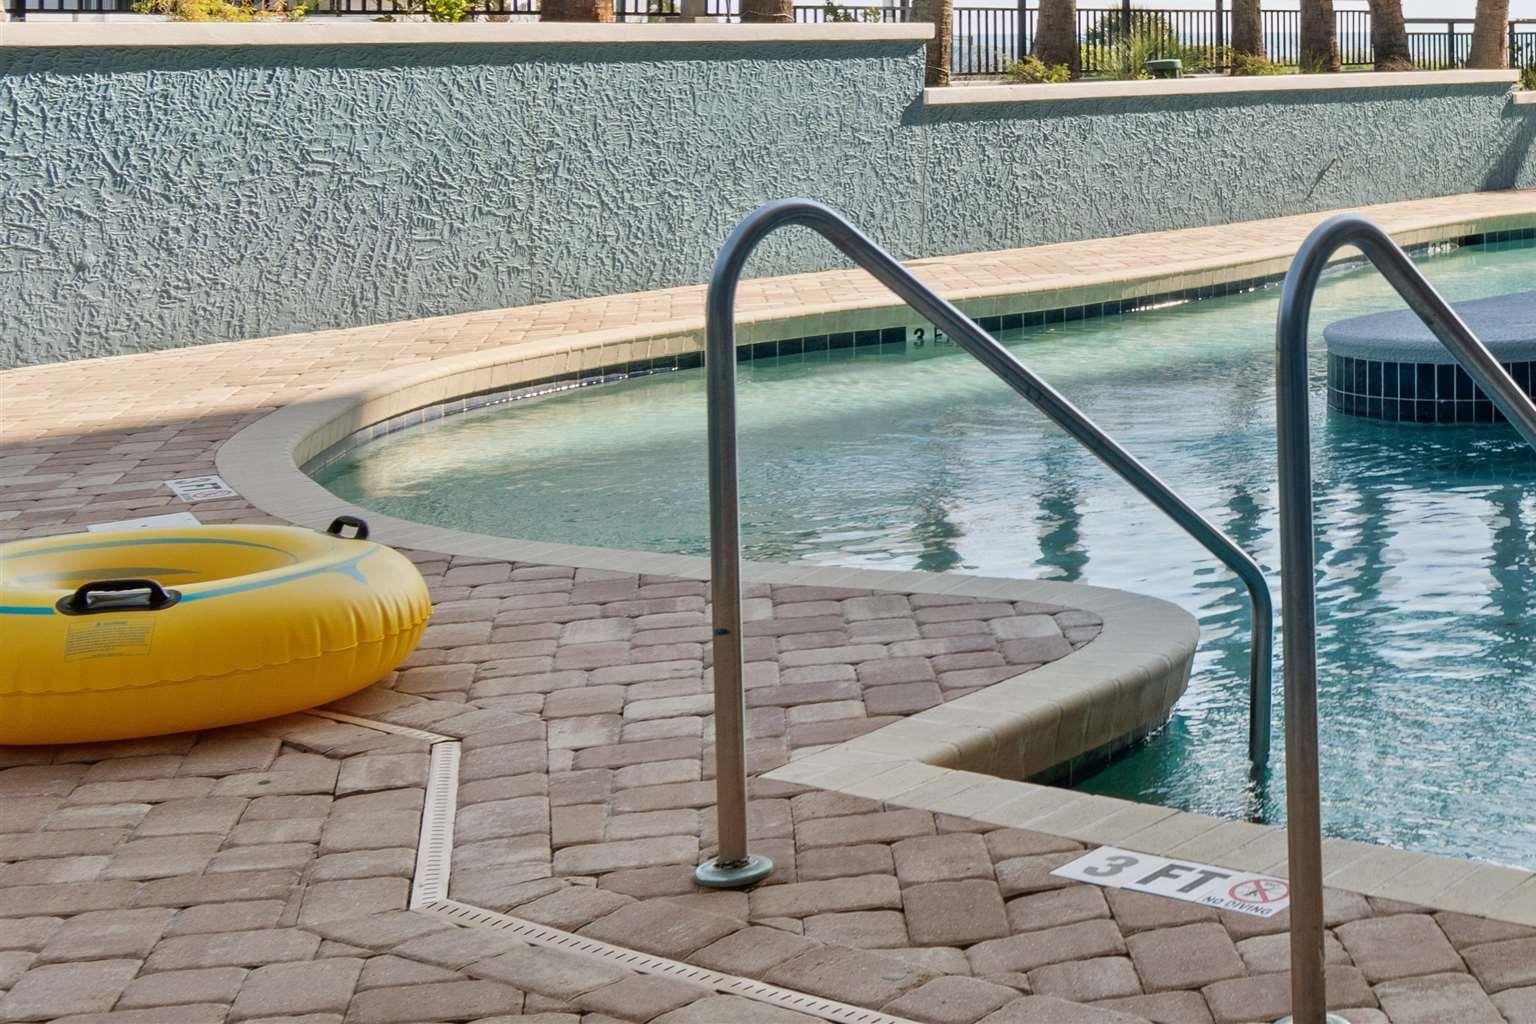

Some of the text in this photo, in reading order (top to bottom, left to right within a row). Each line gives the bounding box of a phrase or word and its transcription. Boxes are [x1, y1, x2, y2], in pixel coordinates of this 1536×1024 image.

[1083, 855, 1232, 894] 3 FT
[1203, 895, 1273, 915] NO DIVING
